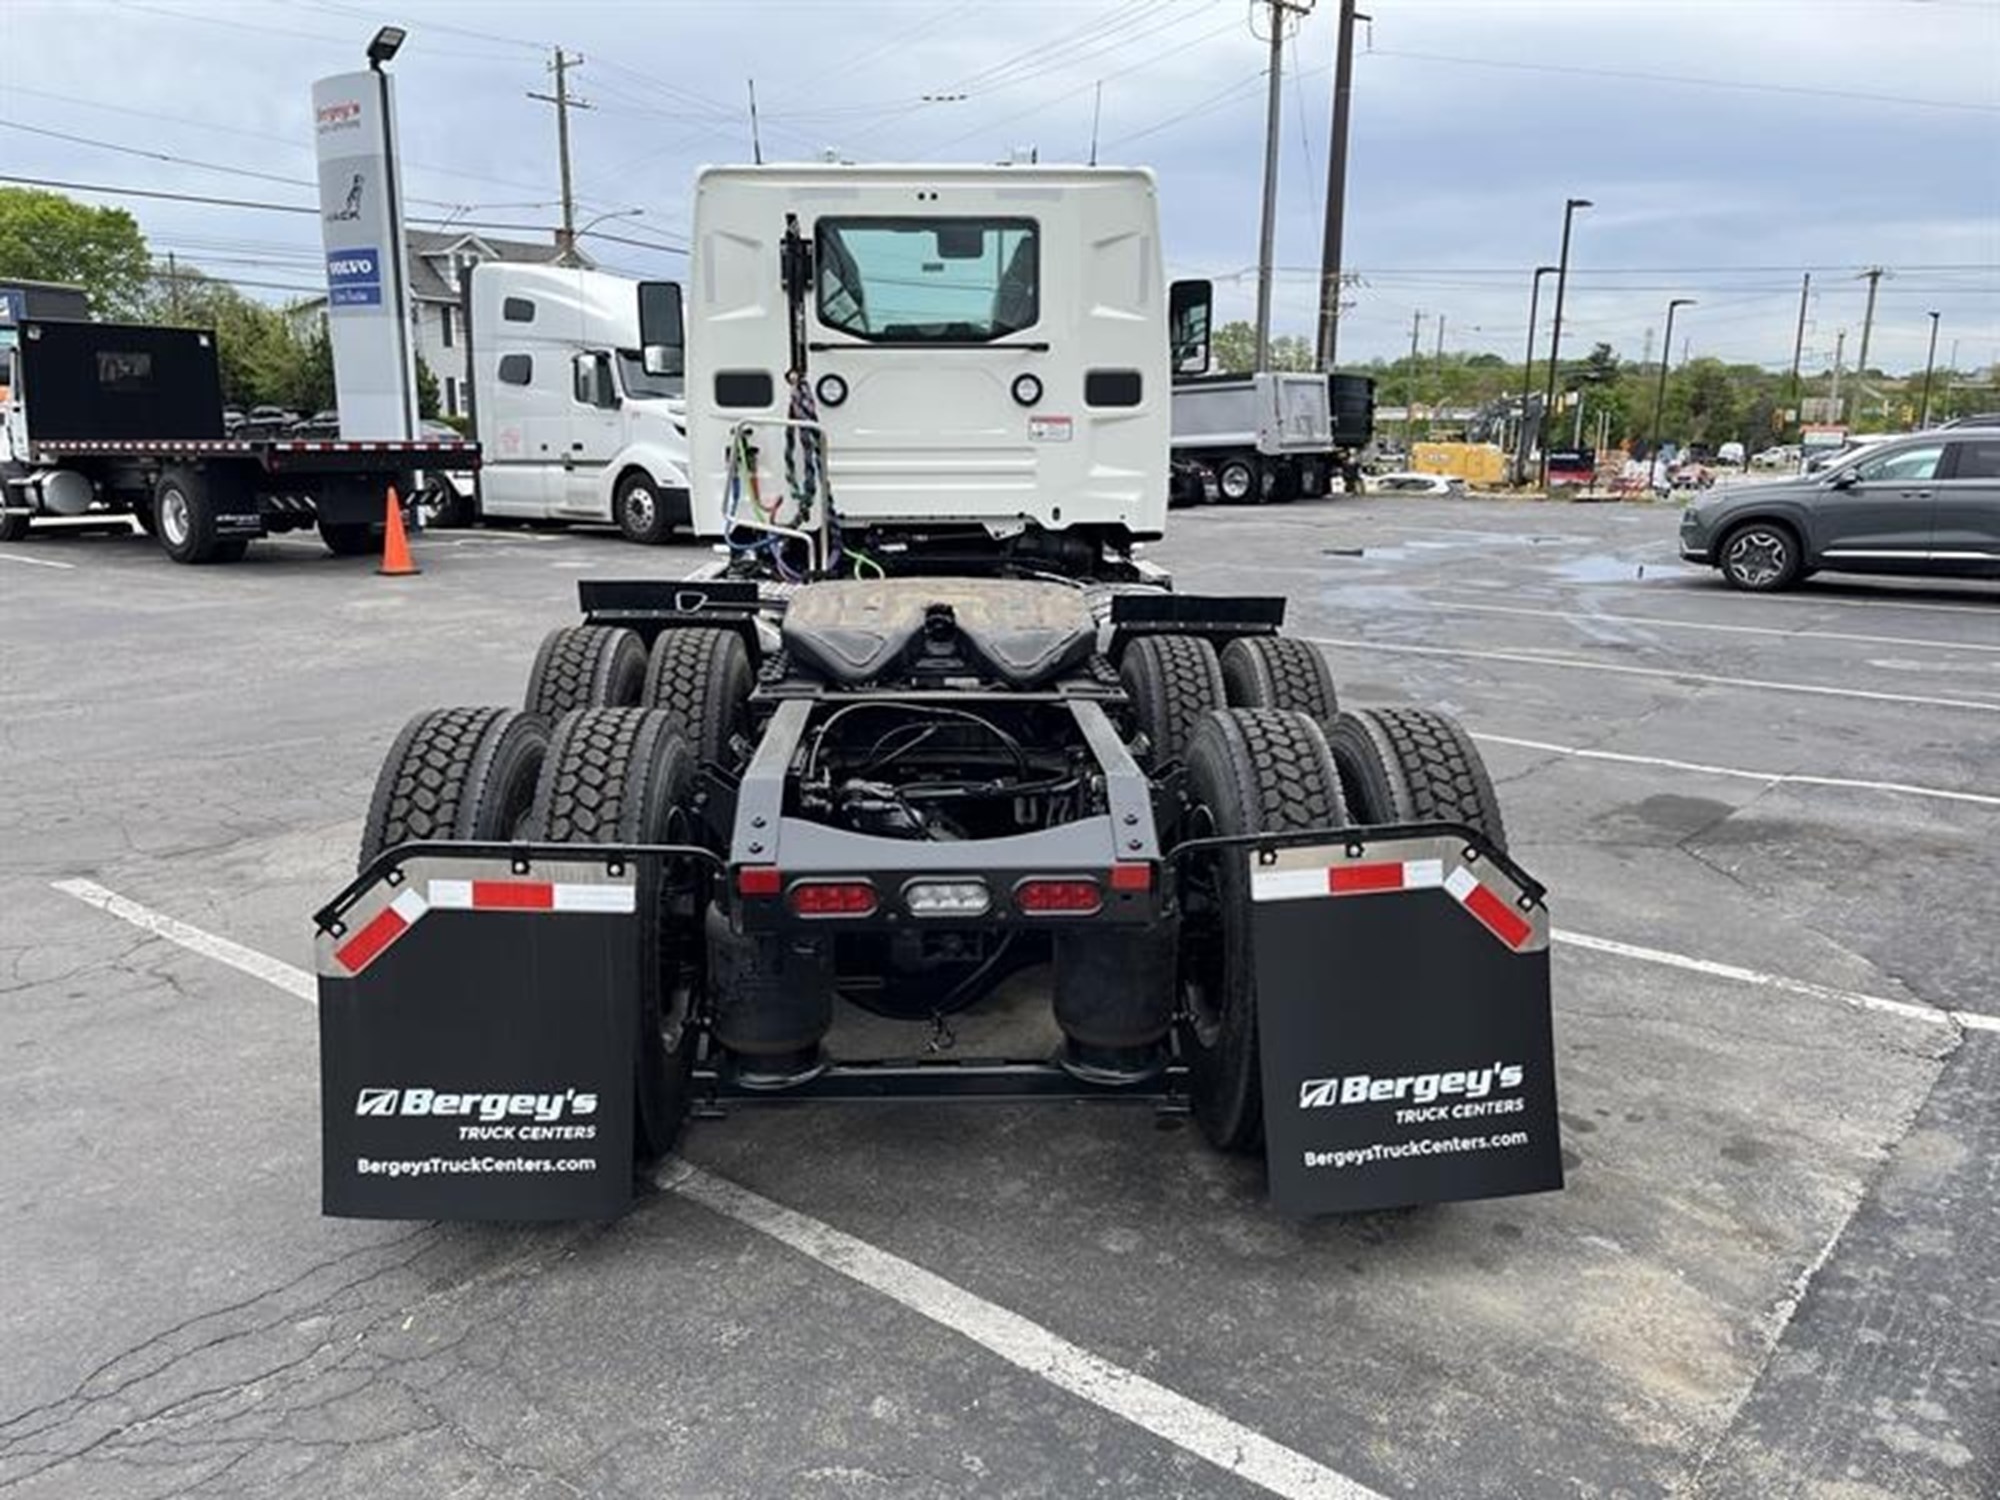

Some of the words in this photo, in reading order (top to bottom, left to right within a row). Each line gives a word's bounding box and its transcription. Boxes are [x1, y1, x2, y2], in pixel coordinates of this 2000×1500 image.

[1340, 1061, 1523, 1104] Bergey's
[400, 1088, 597, 1121] Bergey's
[1396, 1106, 1449, 1124] TRUCK
[1452, 1098, 1524, 1118] CENTERS
[459, 1126, 516, 1140] TRUCK
[518, 1125, 596, 1140] CENTERS
[1304, 1132, 1528, 1167] BergeysTruckCenters.com
[358, 1157, 597, 1177] BergeysTruckCenters.com
